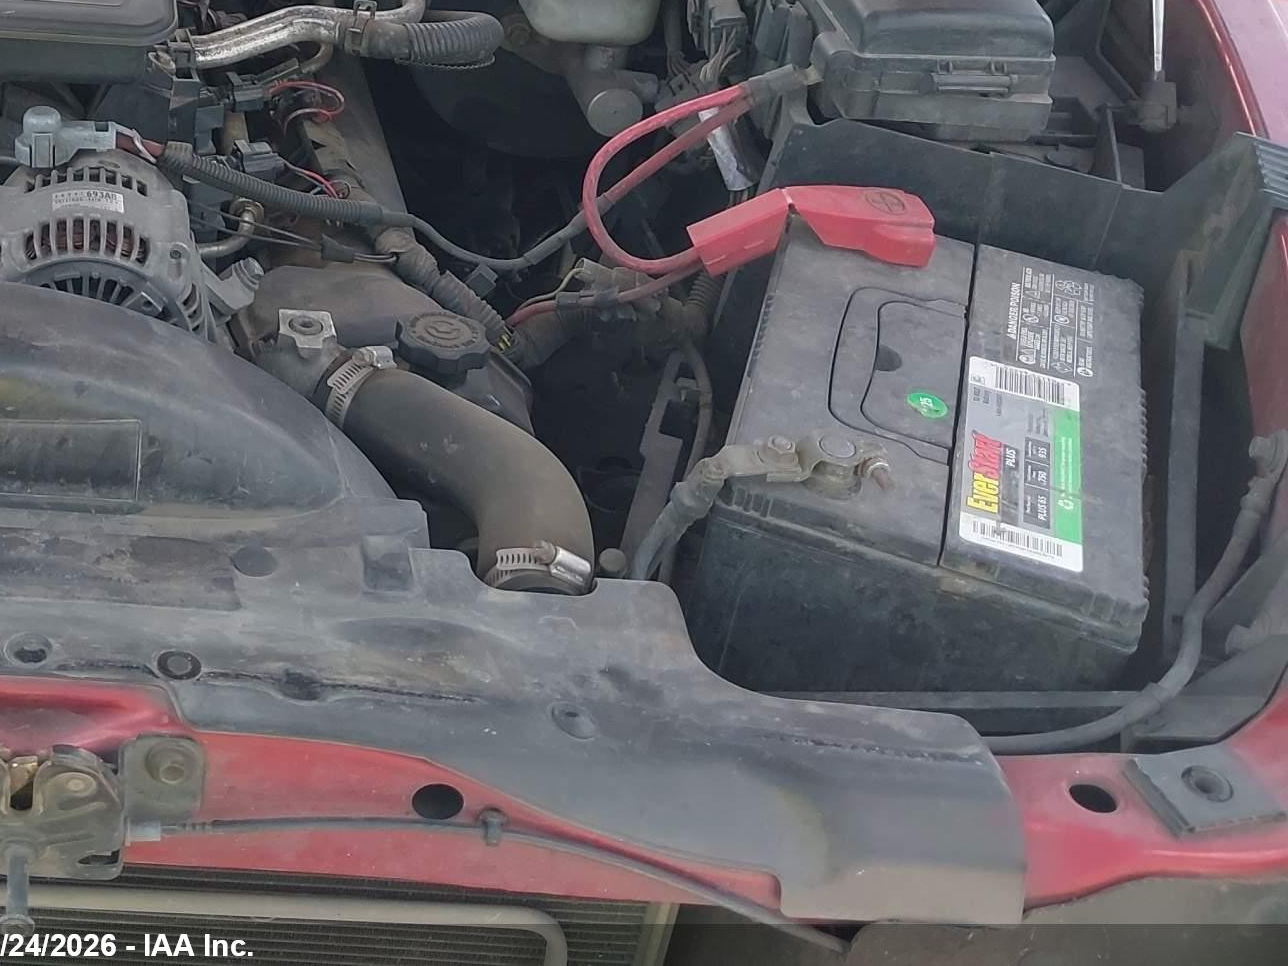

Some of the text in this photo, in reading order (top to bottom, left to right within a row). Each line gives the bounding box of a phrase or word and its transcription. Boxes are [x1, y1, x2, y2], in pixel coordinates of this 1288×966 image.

[1006, 448, 1016, 467] PLUS
[966, 430, 1003, 514] EverStart
[1037, 504, 1047, 521] PLUS
